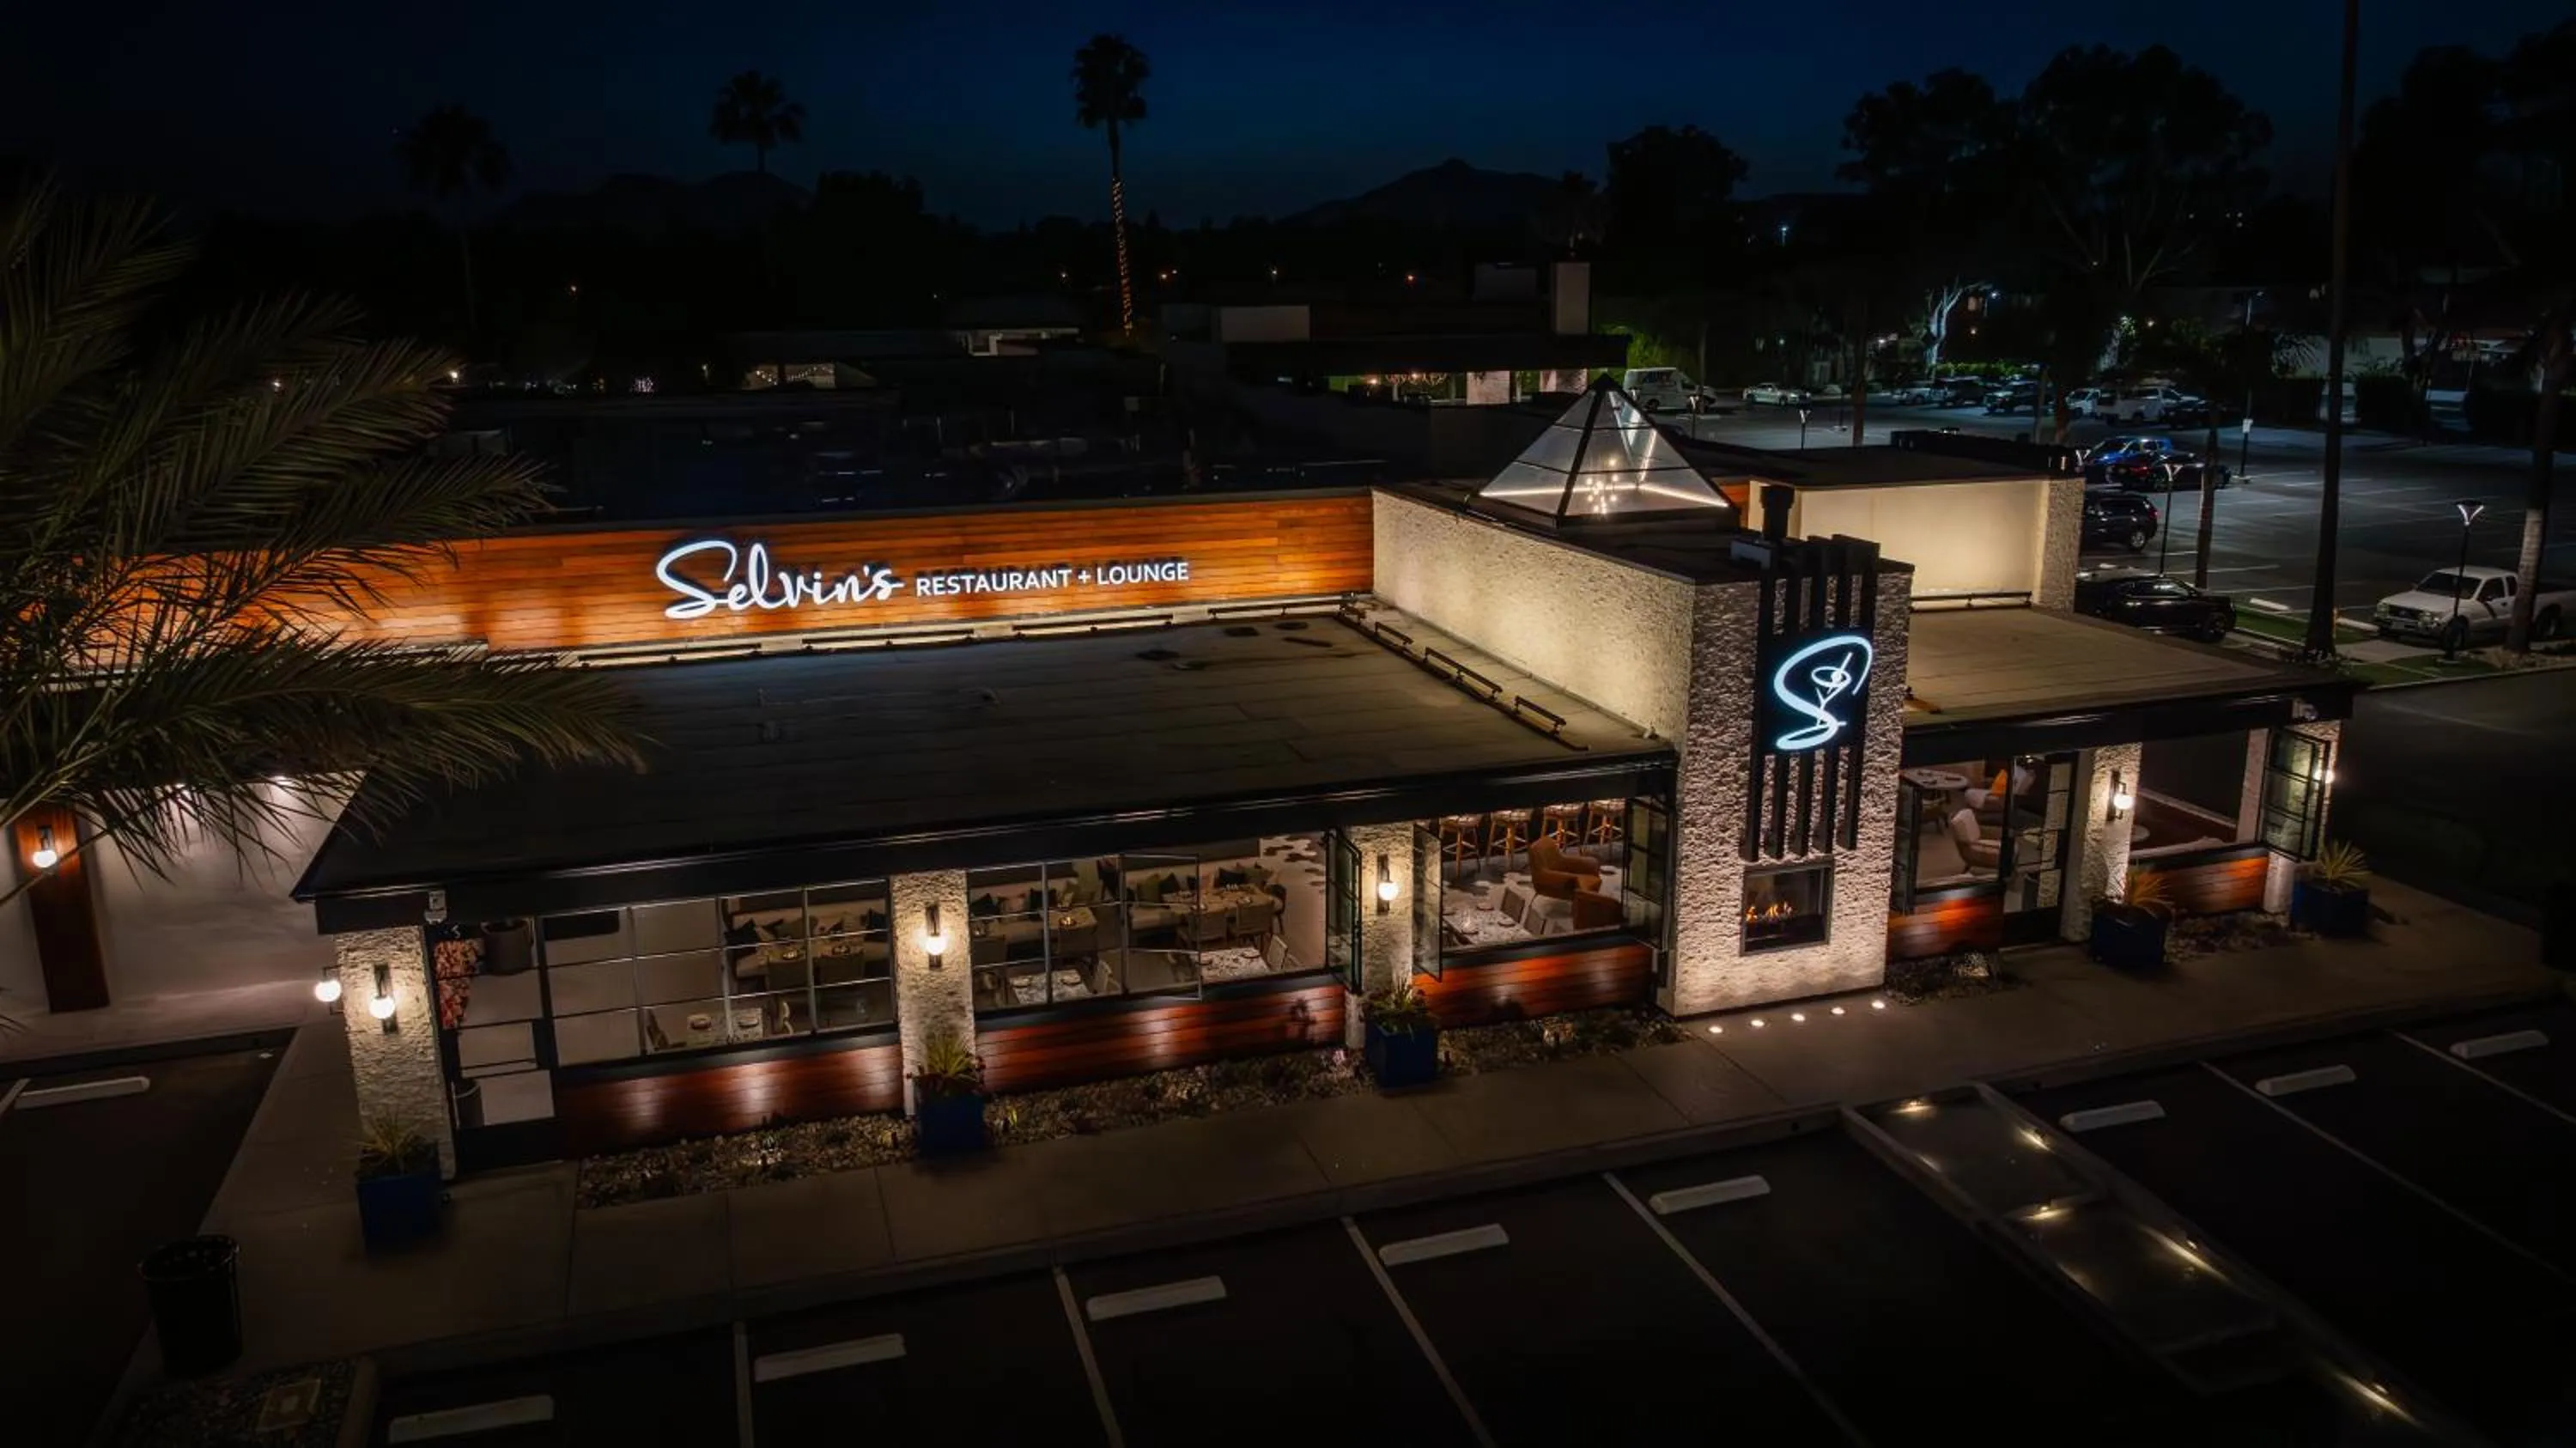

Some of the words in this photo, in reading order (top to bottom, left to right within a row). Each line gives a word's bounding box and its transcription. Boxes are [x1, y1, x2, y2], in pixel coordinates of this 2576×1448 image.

[657, 540, 903, 619] Selvin's
[915, 569, 1072, 597] RESTAURANT
[1097, 563, 1190, 585] LOUNGE
[1774, 636, 1874, 751] S
